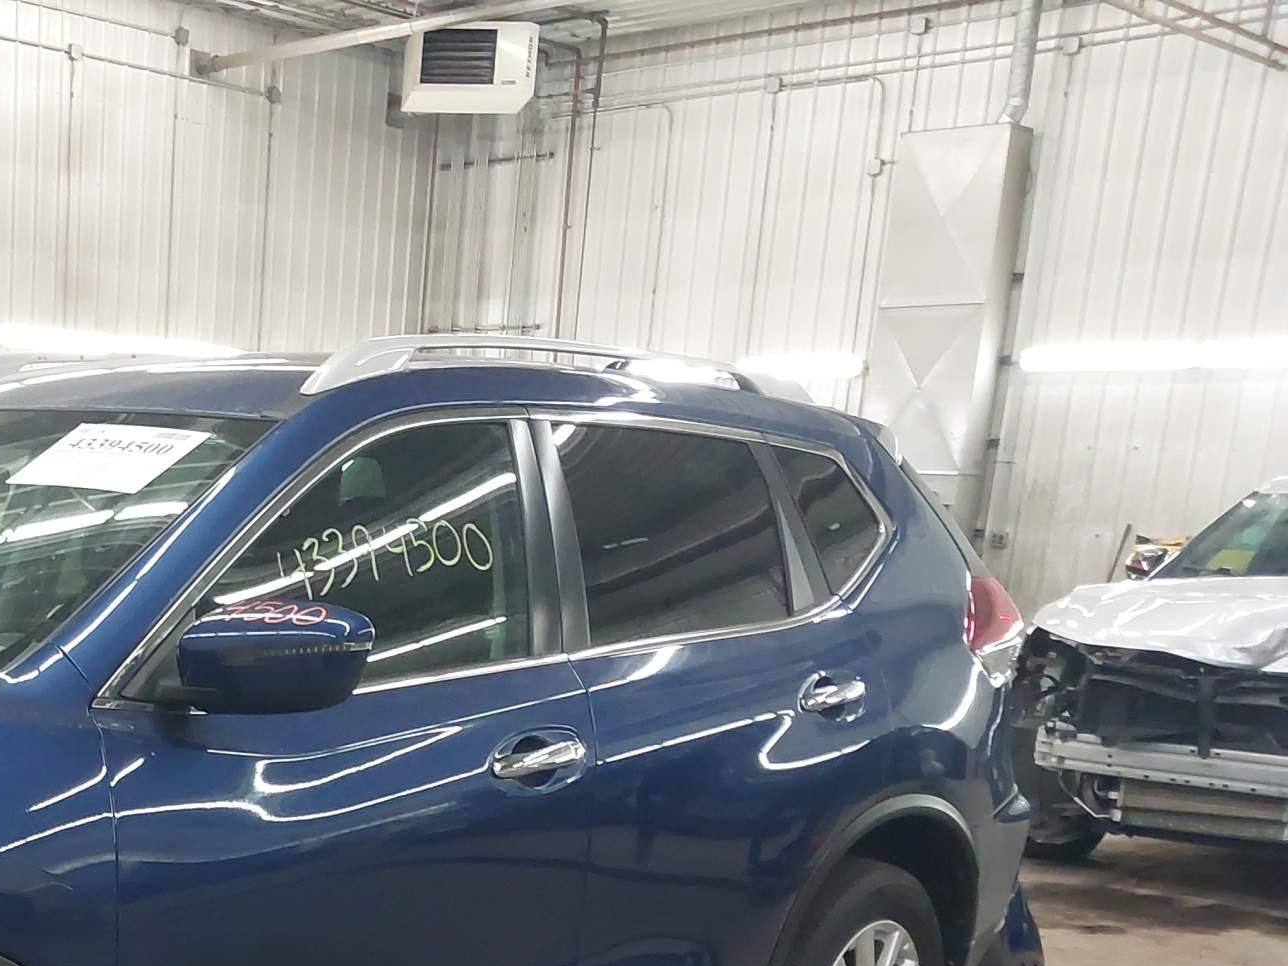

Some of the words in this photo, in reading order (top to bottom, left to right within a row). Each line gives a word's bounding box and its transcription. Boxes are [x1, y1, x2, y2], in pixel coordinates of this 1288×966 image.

[68, 437, 175, 455] 43394500
[275, 517, 494, 601] 43394500
[225, 600, 328, 626] 4500
